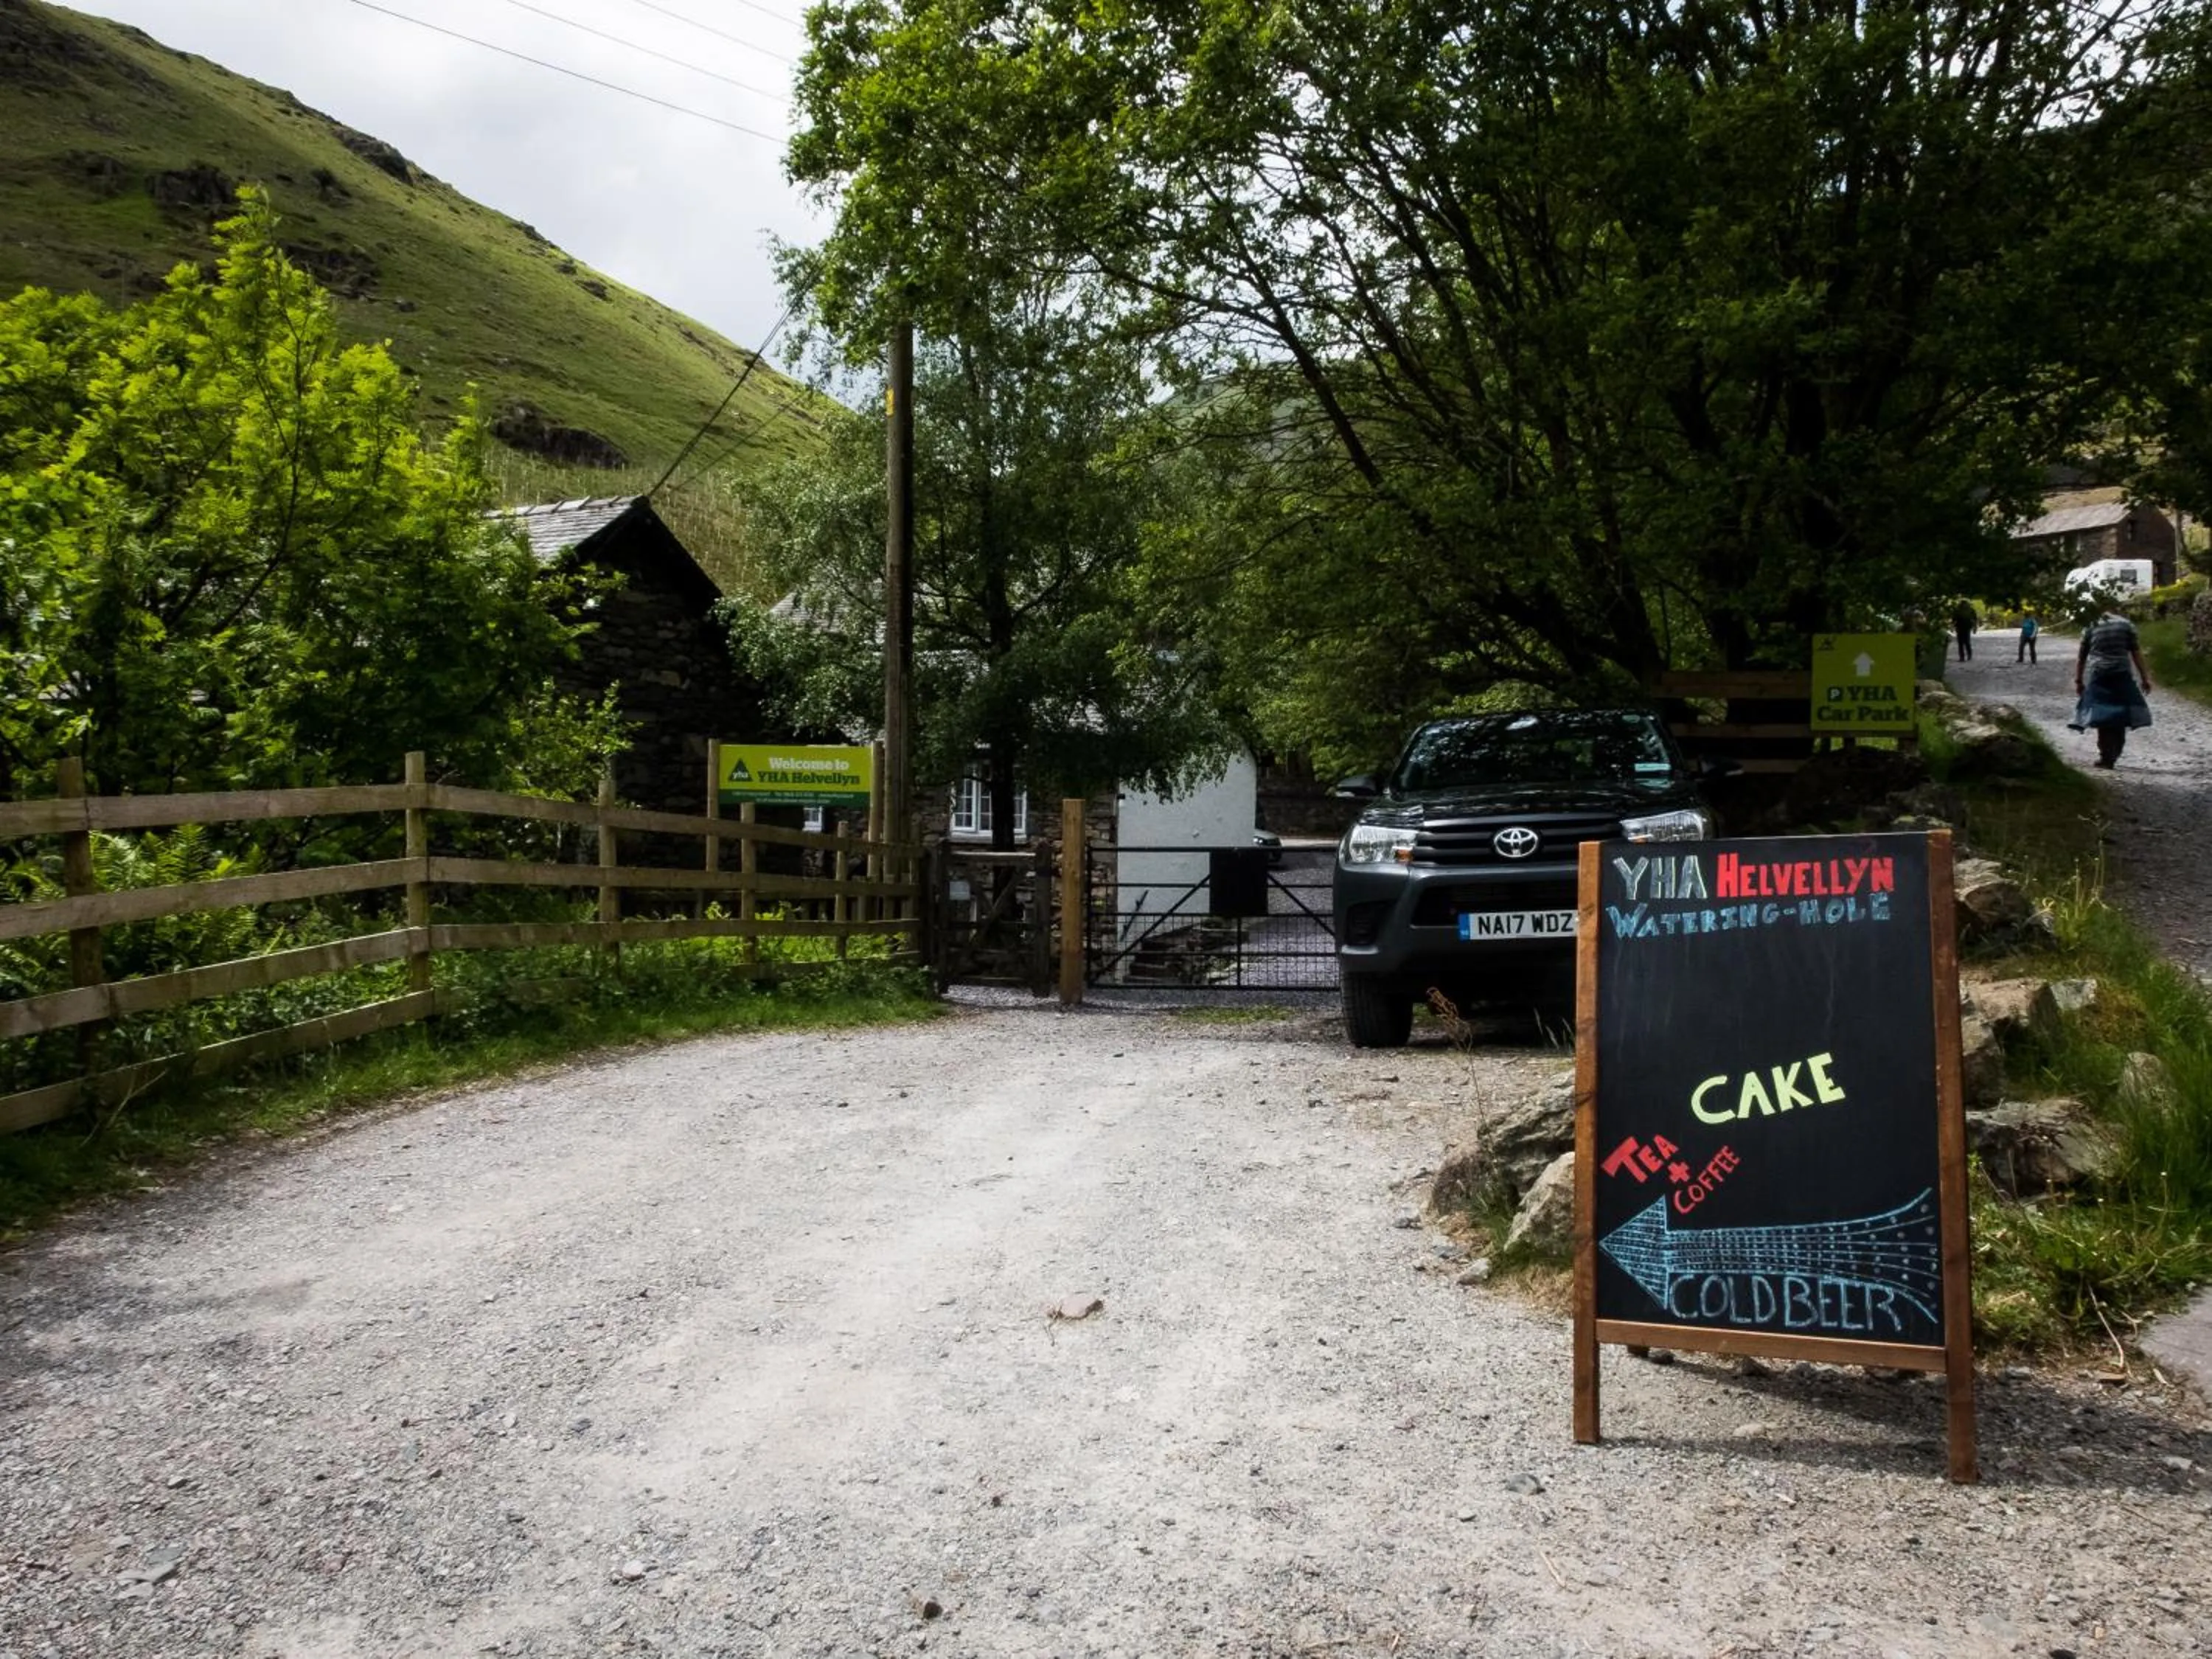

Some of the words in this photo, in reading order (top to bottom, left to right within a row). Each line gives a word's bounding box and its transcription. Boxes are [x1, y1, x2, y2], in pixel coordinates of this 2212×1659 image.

[1846, 686, 1898, 700] YHA
[1817, 706, 1854, 721] Car
[1857, 706, 1909, 721] Park
[732, 771, 748, 780] yha
[758, 771, 791, 784] YHA
[793, 771, 860, 787] Helvellyn
[769, 757, 835, 770] Welcome
[836, 758, 849, 770] to
[1613, 855, 1708, 900] YHA
[1717, 853, 1894, 897] HELVELLYN
[1478, 915, 1524, 935] NA17
[1531, 913, 1573, 932] WDZ
[1605, 891, 1891, 939] WATERING-HOLE
[1691, 1052, 1846, 1124] CAKE
[1600, 1134, 1680, 1183] TEA
[1674, 1144, 1741, 1214] COFFEE
[1669, 1273, 1777, 1324] COLD
[1783, 1274, 1902, 1331] BEER
